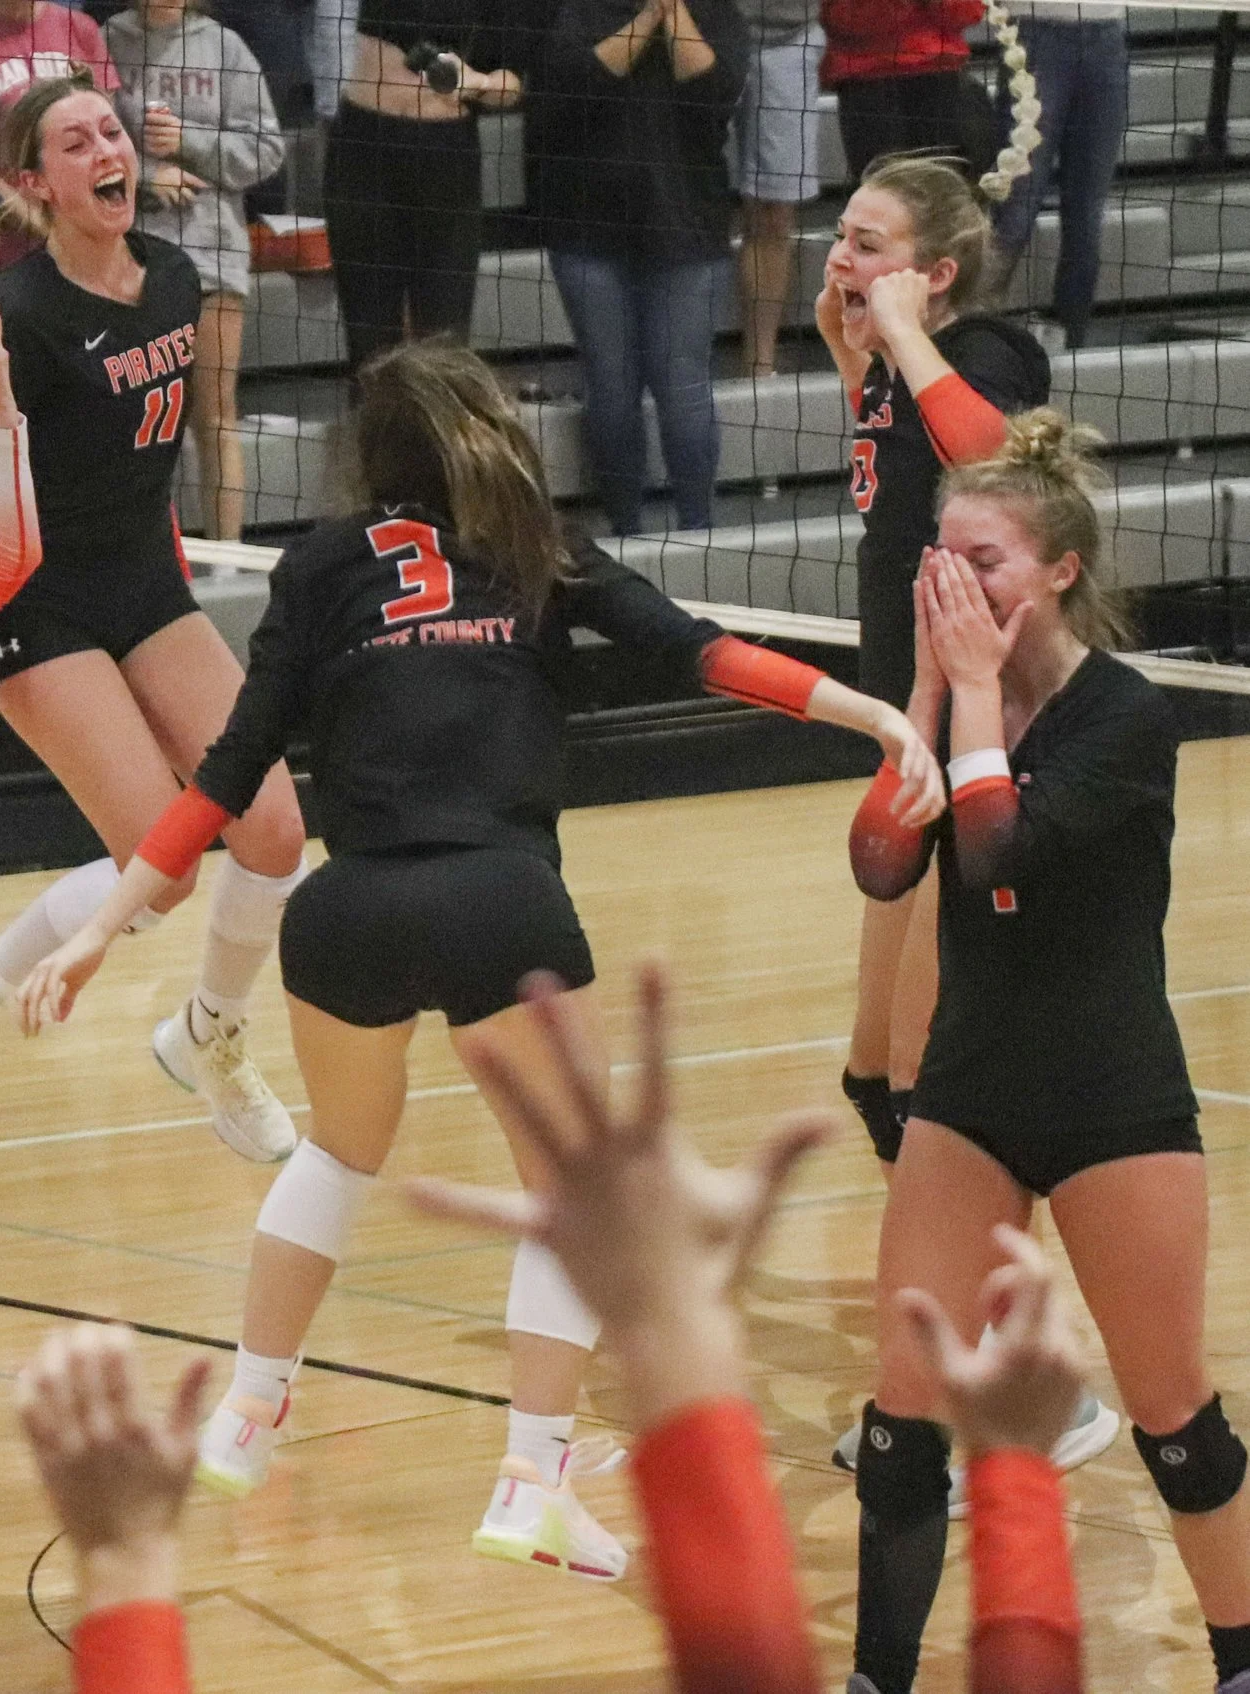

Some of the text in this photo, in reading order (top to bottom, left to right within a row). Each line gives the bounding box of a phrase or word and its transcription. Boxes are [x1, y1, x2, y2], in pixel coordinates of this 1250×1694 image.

[134, 377, 183, 449] 11
[365, 518, 453, 625] 3
[419, 617, 516, 646] COUNTY
